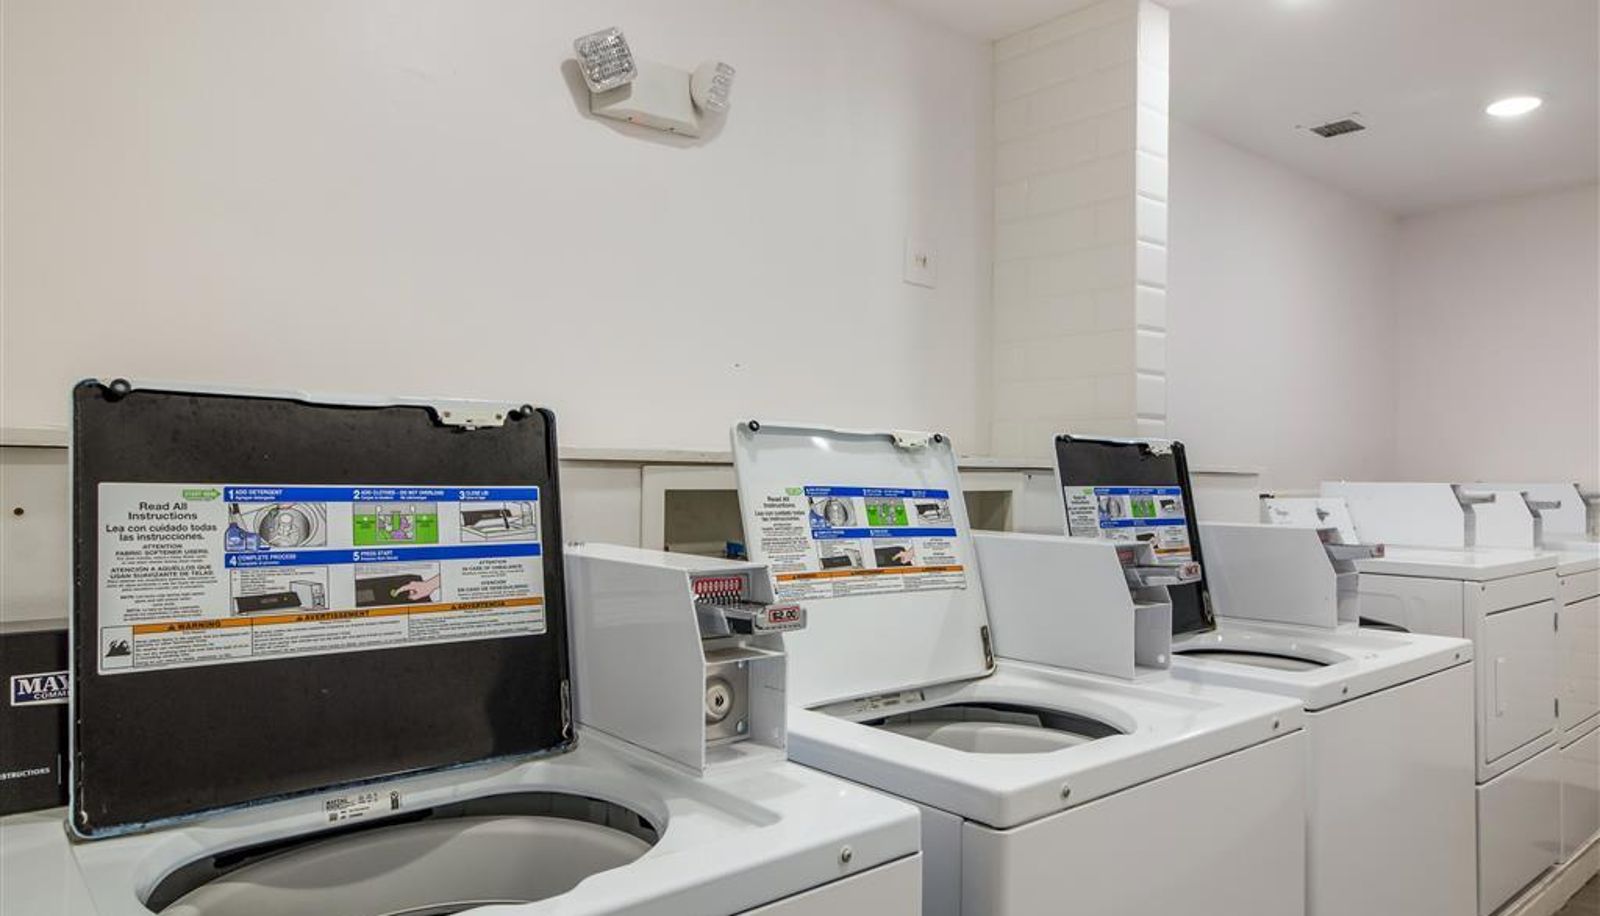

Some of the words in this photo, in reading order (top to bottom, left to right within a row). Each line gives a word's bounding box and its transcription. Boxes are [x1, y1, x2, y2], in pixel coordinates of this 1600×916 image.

[228, 490, 234, 499] 1
[353, 490, 360, 499] 2
[459, 490, 464, 499] 3
[139, 502, 170, 510] Read
[172, 502, 188, 510] All
[128, 512, 197, 520] Instructions
[106, 524, 125, 532] Lea
[127, 524, 147, 532] con
[149, 524, 188, 532] cuidado
[190, 523, 217, 531] todas
[119, 533, 134, 541] las
[137, 533, 205, 541] instrucciones.
[353, 551, 360, 561] 5
[229, 556, 237, 566] 4
[458, 600, 506, 609] ADVERTENCIA
[305, 610, 370, 621] AVERTISSEMENT
[178, 620, 222, 630] WARNING
[0, 767, 50, 780] STRUCTIONS
